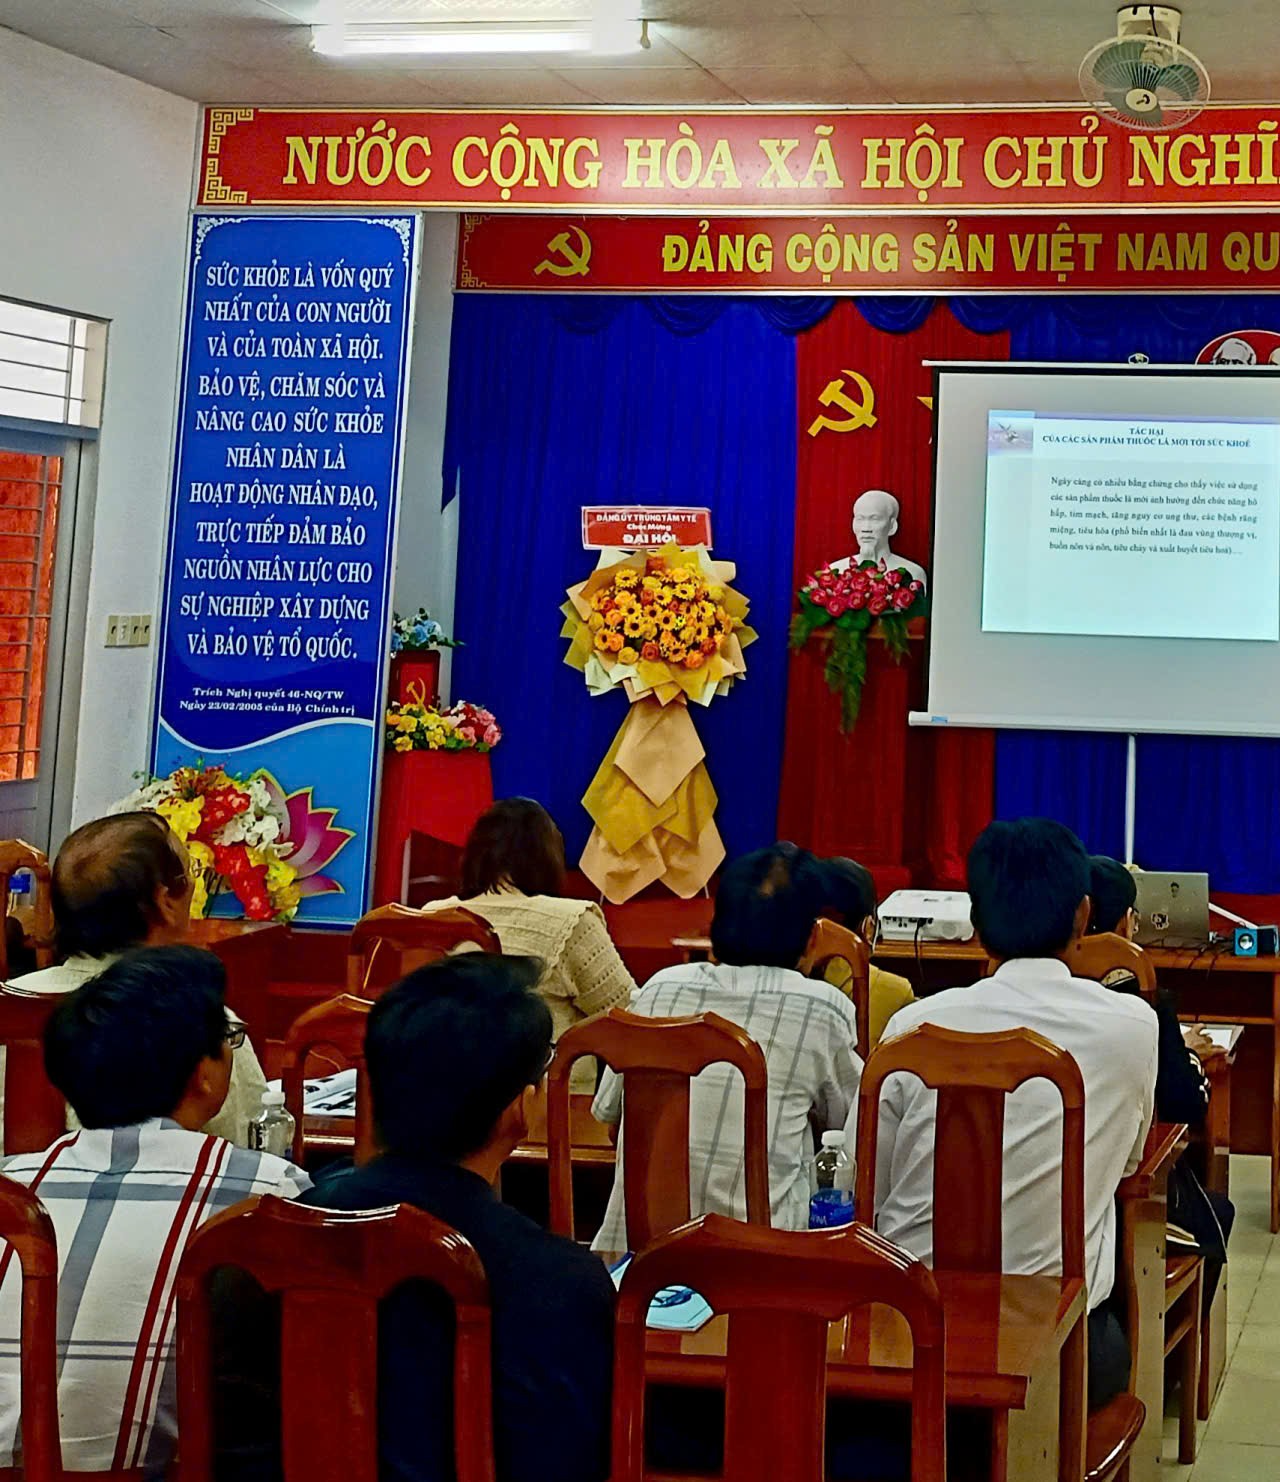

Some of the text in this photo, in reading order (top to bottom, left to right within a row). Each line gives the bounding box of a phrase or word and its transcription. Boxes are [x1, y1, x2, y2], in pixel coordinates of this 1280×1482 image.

[283, 120, 431, 186] NƯỚC
[453, 123, 603, 200] CỘNG
[623, 122, 740, 188] HÒA
[757, 125, 846, 188] XÃ
[861, 123, 963, 202] HỘI
[984, 116, 1107, 188] CHỦ
[662, 220, 773, 272] ĐẢNG
[786, 224, 903, 283] CỘNG
[909, 219, 993, 272] SẢN
[1009, 224, 1102, 281] VIỆT
[1119, 234, 1206, 269] NAM
[207, 259, 394, 292] SỨC KHỎE LÀ VỐN QUÝ
[205, 293, 391, 323] NHẤT CỦA CON NGƯỜI
[208, 330, 382, 363] VÀ CỦA TOÀN XÃ HỘI.
[199, 368, 385, 400] BẢO VỆ, CHĂM SÓC VÀ
[196, 405, 383, 433] NÂNG CAO SỨC KHỎE
[227, 442, 345, 469] NHÂN DÂN LÀ
[190, 479, 377, 510] HOẠT ĐỘNG NHÂN ĐẠO,
[197, 514, 365, 546] TRỰC TIẾP ĐẢM BẢO
[622, 534, 649, 544] ĐẠI
[184, 549, 372, 586] NGUỒN NHÂN LỰC CHO
[181, 592, 369, 624] SỰ NGHIỆP XÂY DỰNG
[188, 627, 356, 661] VÀ BẢO VỆ TỔ QUỐC.
